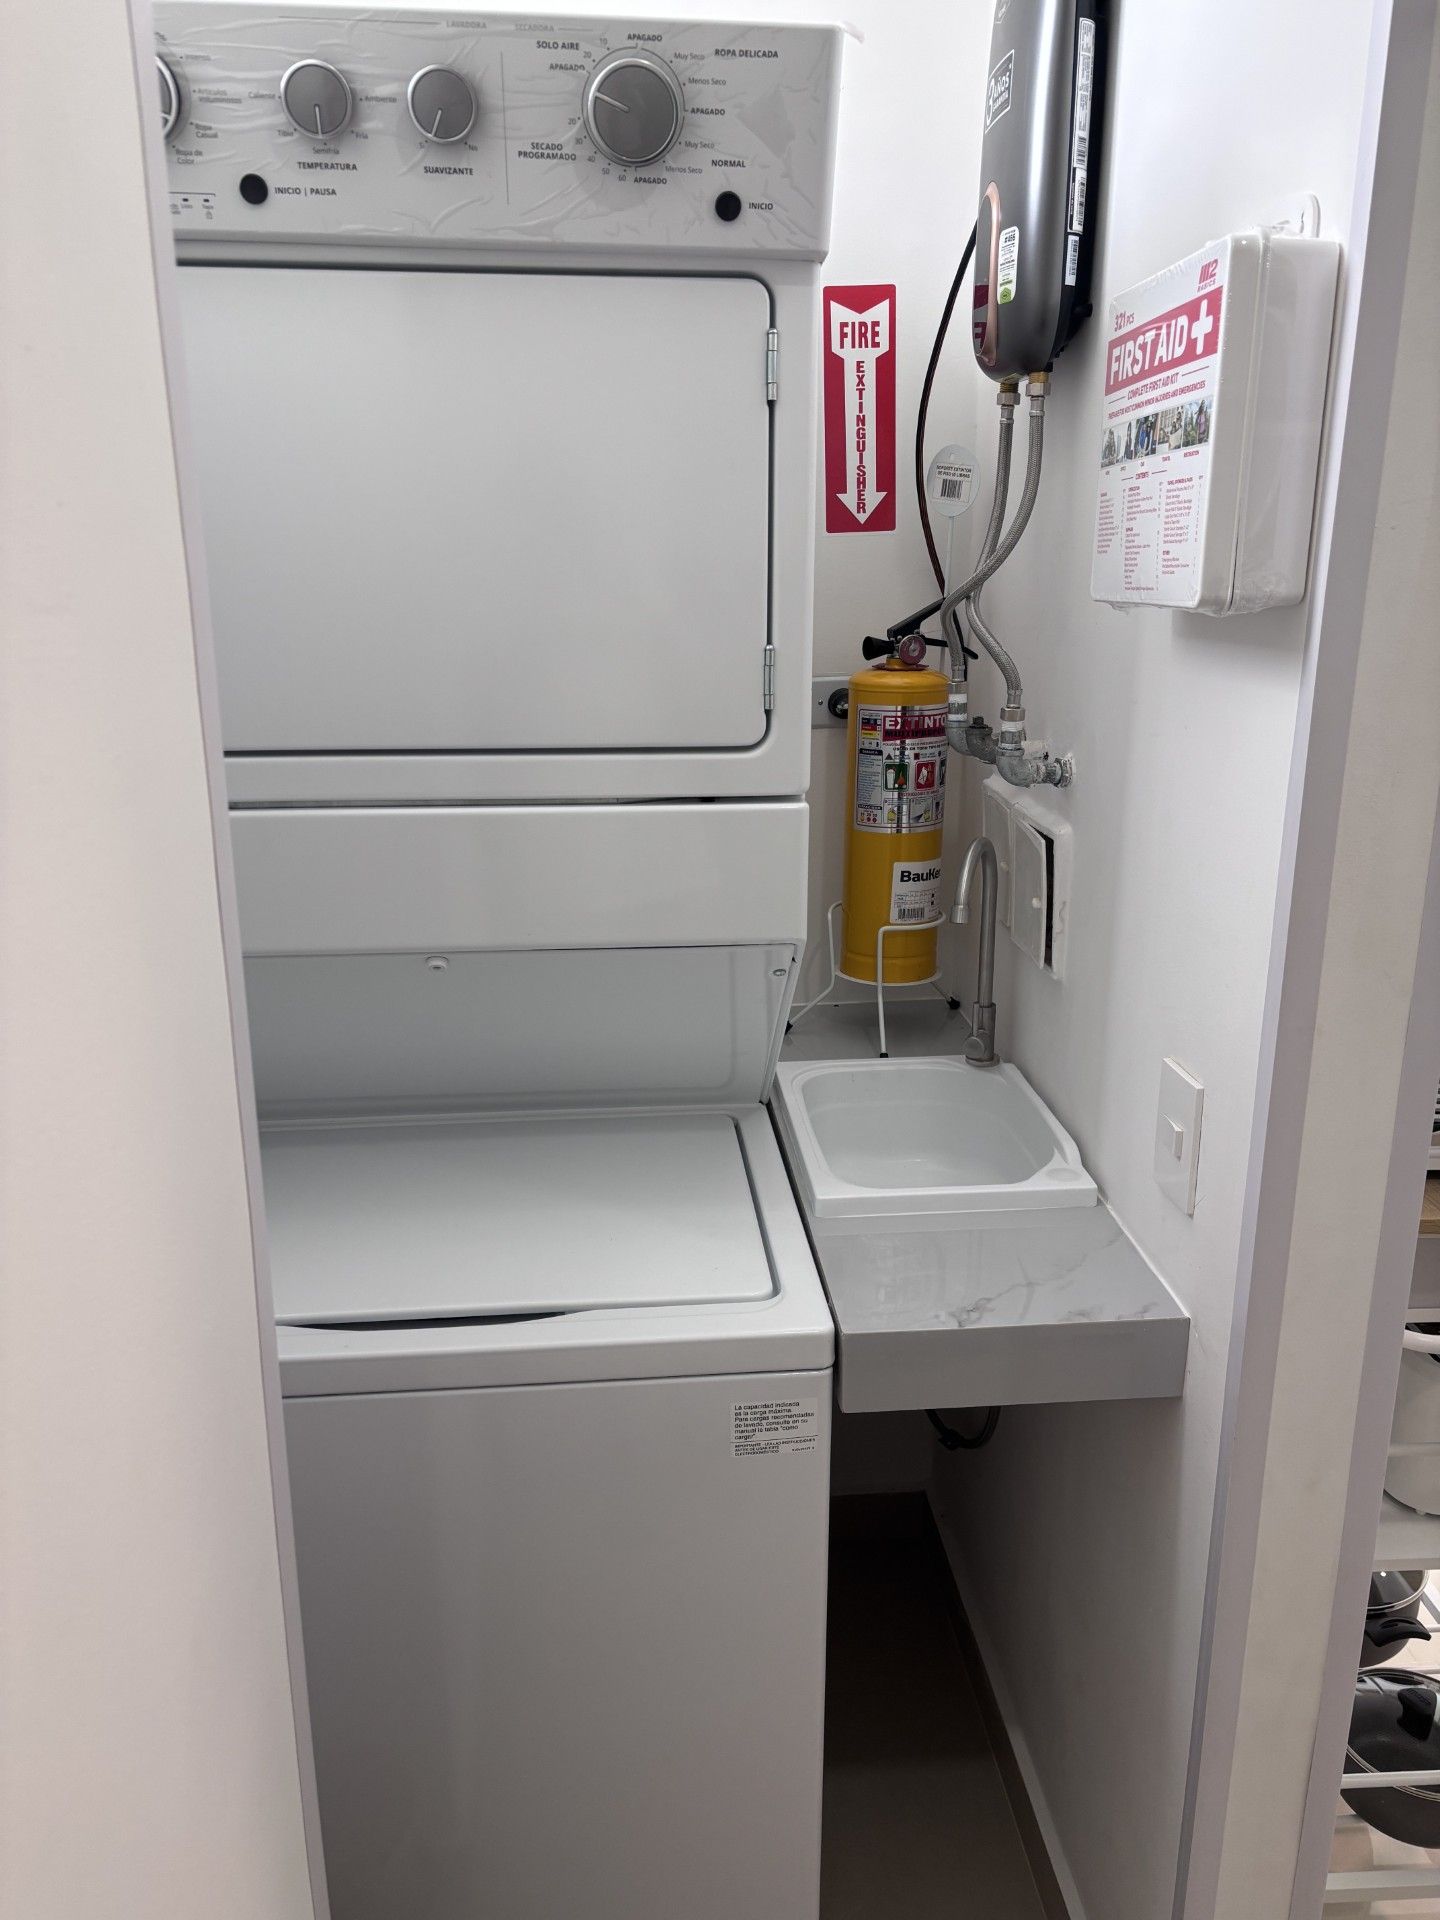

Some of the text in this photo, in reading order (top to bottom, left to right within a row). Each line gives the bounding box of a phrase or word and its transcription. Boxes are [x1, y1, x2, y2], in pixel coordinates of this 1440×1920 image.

[627, 33, 663, 42] APAGADO
[536, 40, 580, 50] SOLO AIRE
[674, 52, 705, 60] Muy Seco
[714, 48, 779, 59] ROPA DELICADA
[549, 63, 585, 71] APAGADO
[688, 77, 726, 86] Menos Seco
[691, 107, 725, 115] APAGADO
[531, 142, 563, 151] SECADO
[685, 141, 715, 149] Muy Seco
[518, 151, 576, 161] PROGRAMADO
[587, 155, 595, 163] 40
[298, 161, 357, 171] TEMPERATURA
[711, 159, 746, 168] NORMAL
[424, 166, 474, 175] SUAVIZANTE
[618, 174, 626, 182] 60
[275, 187, 336, 196] INICIO PAUSA
[749, 202, 773, 210] INICIO
[1114, 311, 1135, 332] 321 PCS
[839, 320, 880, 349] FIRE
[1110, 314, 1189, 385] FIRST AID
[1127, 372, 1179, 400] COMPLETE FIRST AID KIT
[1178, 379, 1206, 396] EMERGENCIES
[856, 360, 867, 514] EXTINGUISHER
[771, 1412, 815, 1420] recomendadas
